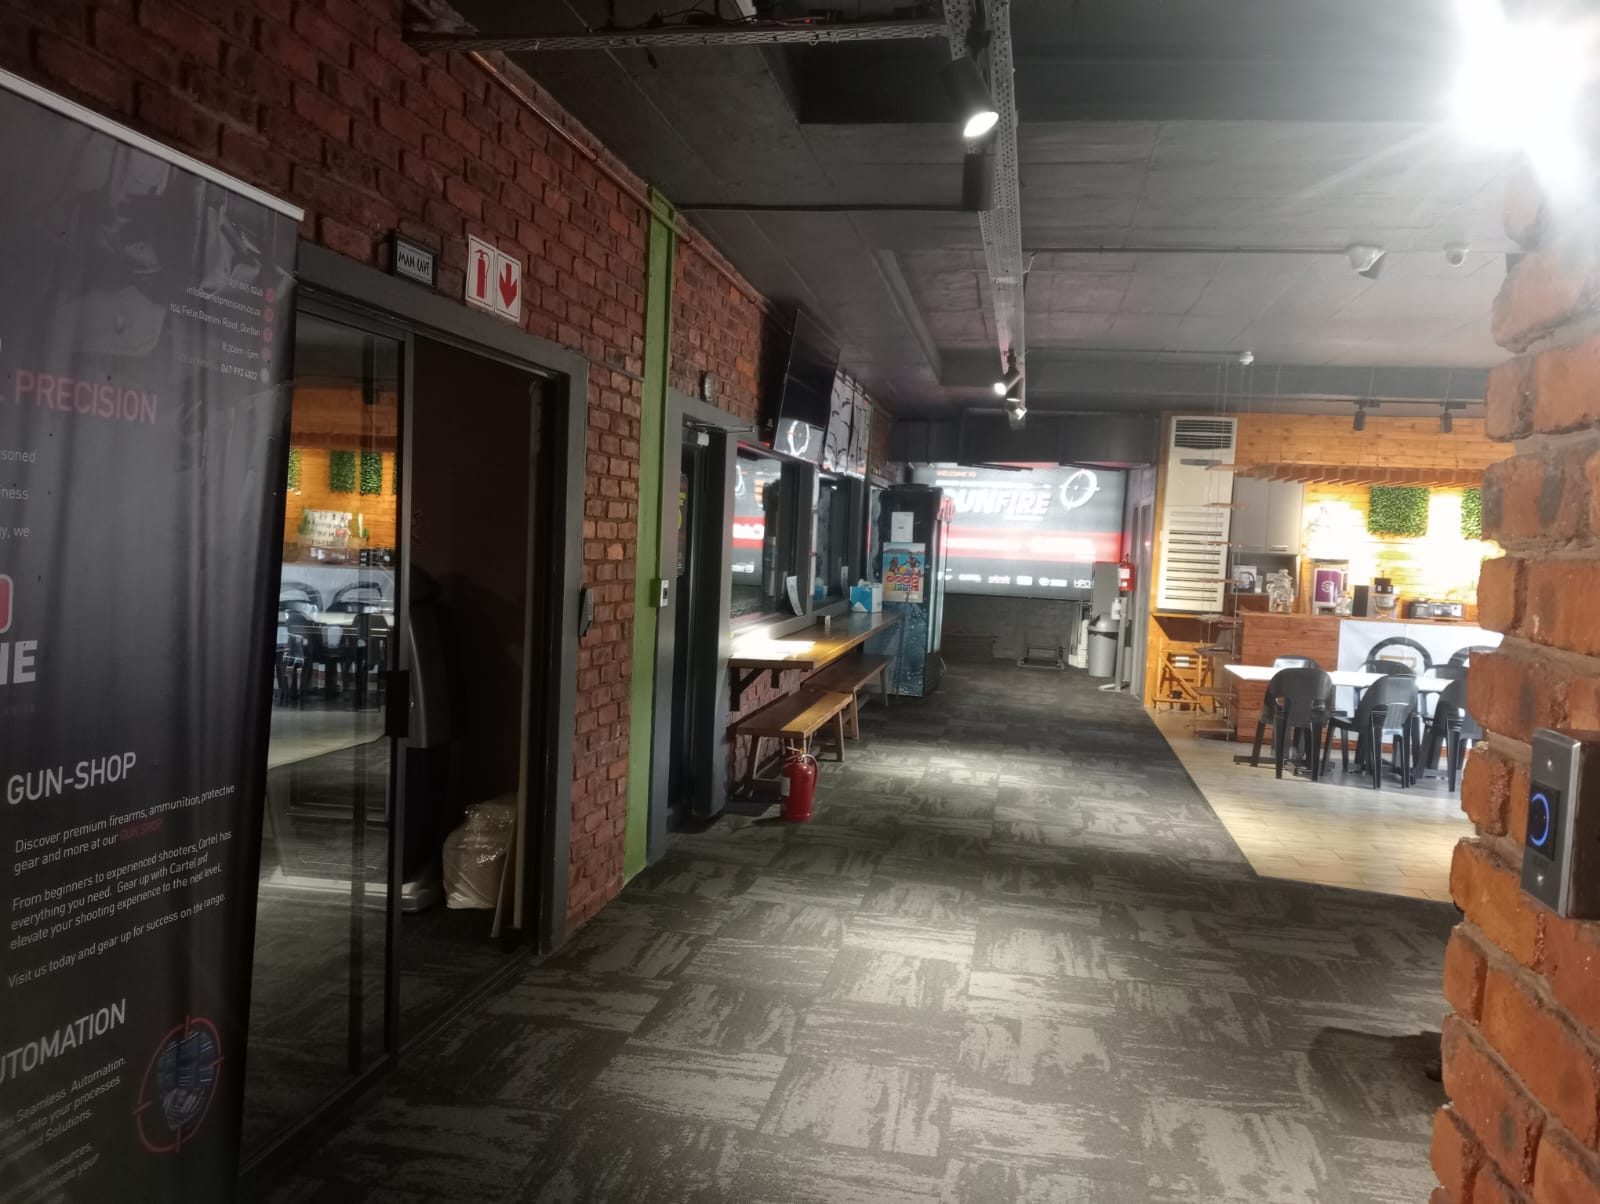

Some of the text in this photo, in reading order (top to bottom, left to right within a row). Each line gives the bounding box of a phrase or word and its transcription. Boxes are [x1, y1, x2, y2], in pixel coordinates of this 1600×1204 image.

[398, 252, 430, 275] MAN CAVE
[15, 369, 158, 425] PRECISION
[13, 527, 31, 538] we
[7, 752, 136, 805] GUN-SHOP
[15, 832, 62, 854] Discover
[62, 820, 107, 843] premium
[201, 785, 235, 803] protective
[12, 894, 42, 912] From
[44, 876, 94, 901] beginners
[95, 872, 104, 884] to
[106, 852, 157, 880] experienced
[198, 832, 218, 850] Cartel
[14, 856, 40, 876] gear
[42, 849, 61, 865] and
[63, 842, 89, 858] more
[90, 837, 100, 850] at
[102, 833, 119, 847] our
[10, 904, 66, 931] everything
[68, 896, 85, 914] you
[87, 886, 112, 904] need.
[116, 876, 138, 893] Gear
[139, 874, 150, 886] up
[150, 866, 168, 880] with
[170, 858, 197, 874] Cartel
[10, 928, 48, 950] elevate
[50, 918, 73, 938] your
[75, 903, 115, 926] shooting
[116, 886, 161, 910] experience
[162, 882, 171, 894] to
[172, 877, 188, 889] the
[8, 969, 32, 988] Visit
[33, 964, 47, 978] us
[48, 953, 76, 972] today
[78, 942, 96, 960] and
[97, 936, 119, 955] gear
[120, 930, 132, 944] up
[133, 923, 145, 938] for
[146, 912, 179, 932] success
[180, 908, 192, 919] on
[16, 1088, 67, 1122] Seamless
[50, 1102, 72, 1124] your
[74, 1076, 121, 1111] processes
